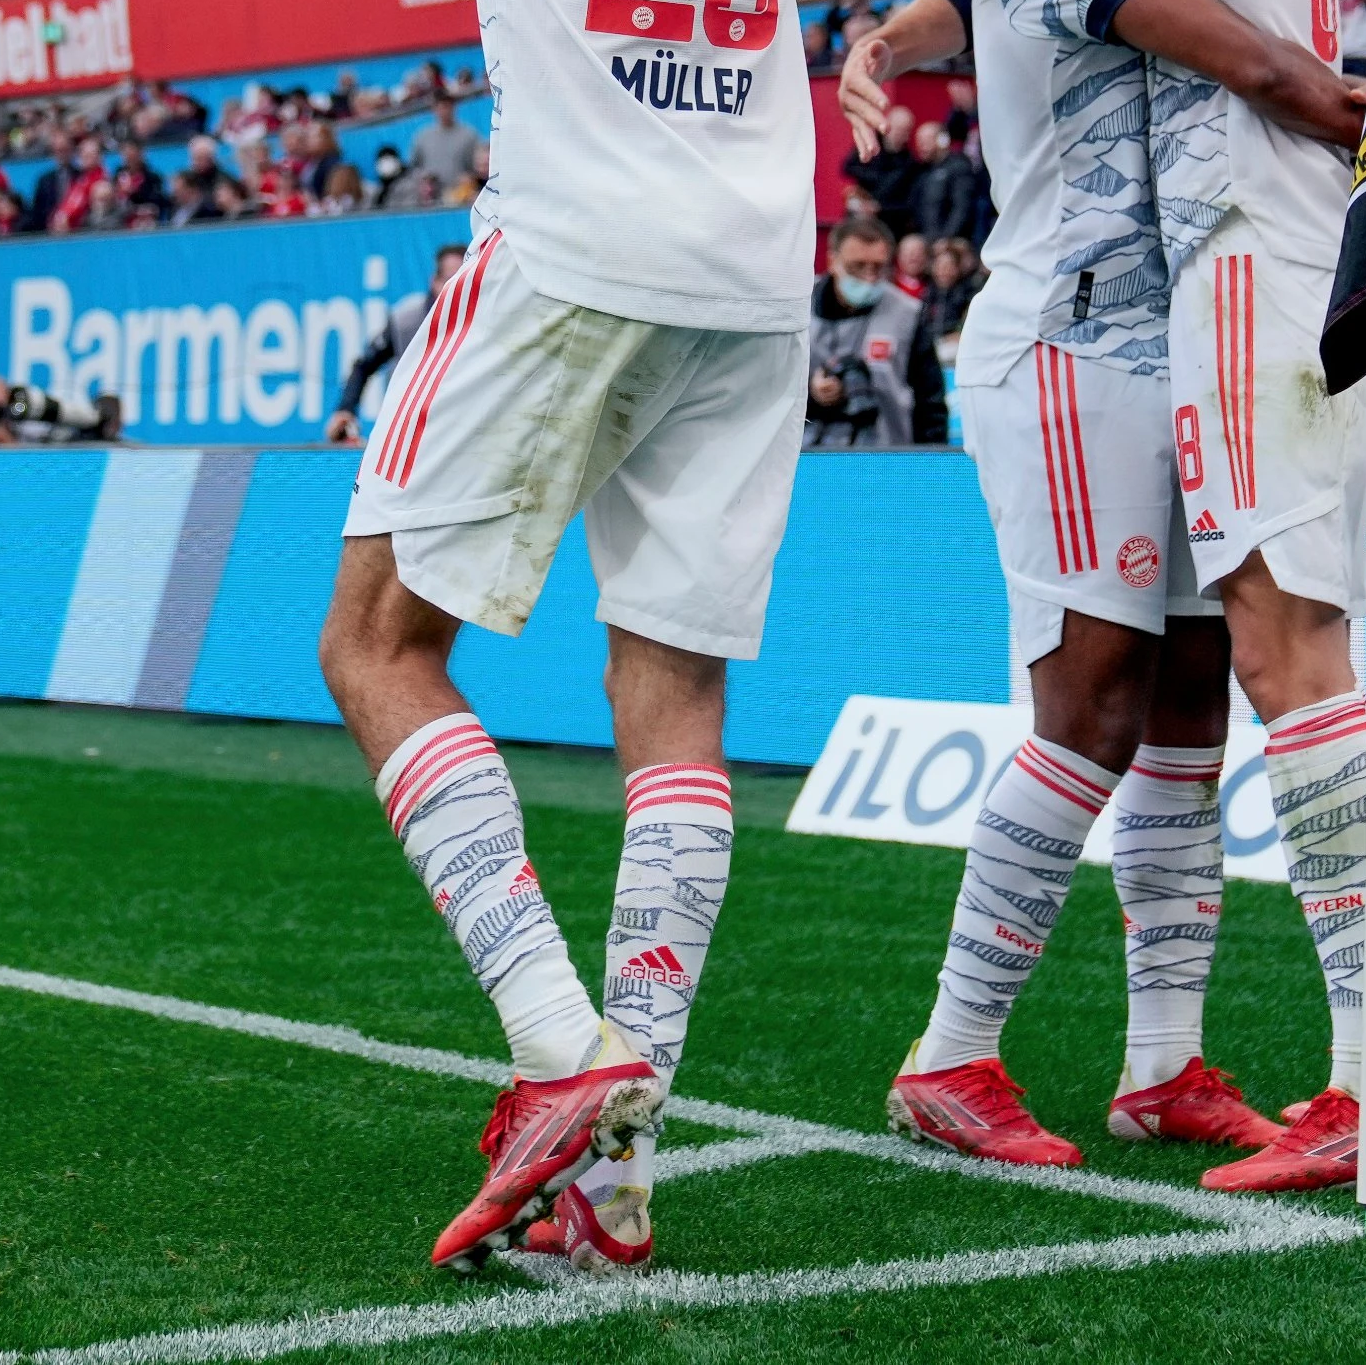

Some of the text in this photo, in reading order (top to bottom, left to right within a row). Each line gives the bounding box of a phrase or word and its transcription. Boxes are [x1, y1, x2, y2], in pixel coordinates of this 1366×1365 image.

[610, 49, 753, 117] MÜLLER
[10, 255, 392, 428] Barmeni
[1175, 404, 1204, 492] 8
[819, 715, 1013, 827] iLO
[621, 966, 692, 987] adidas
